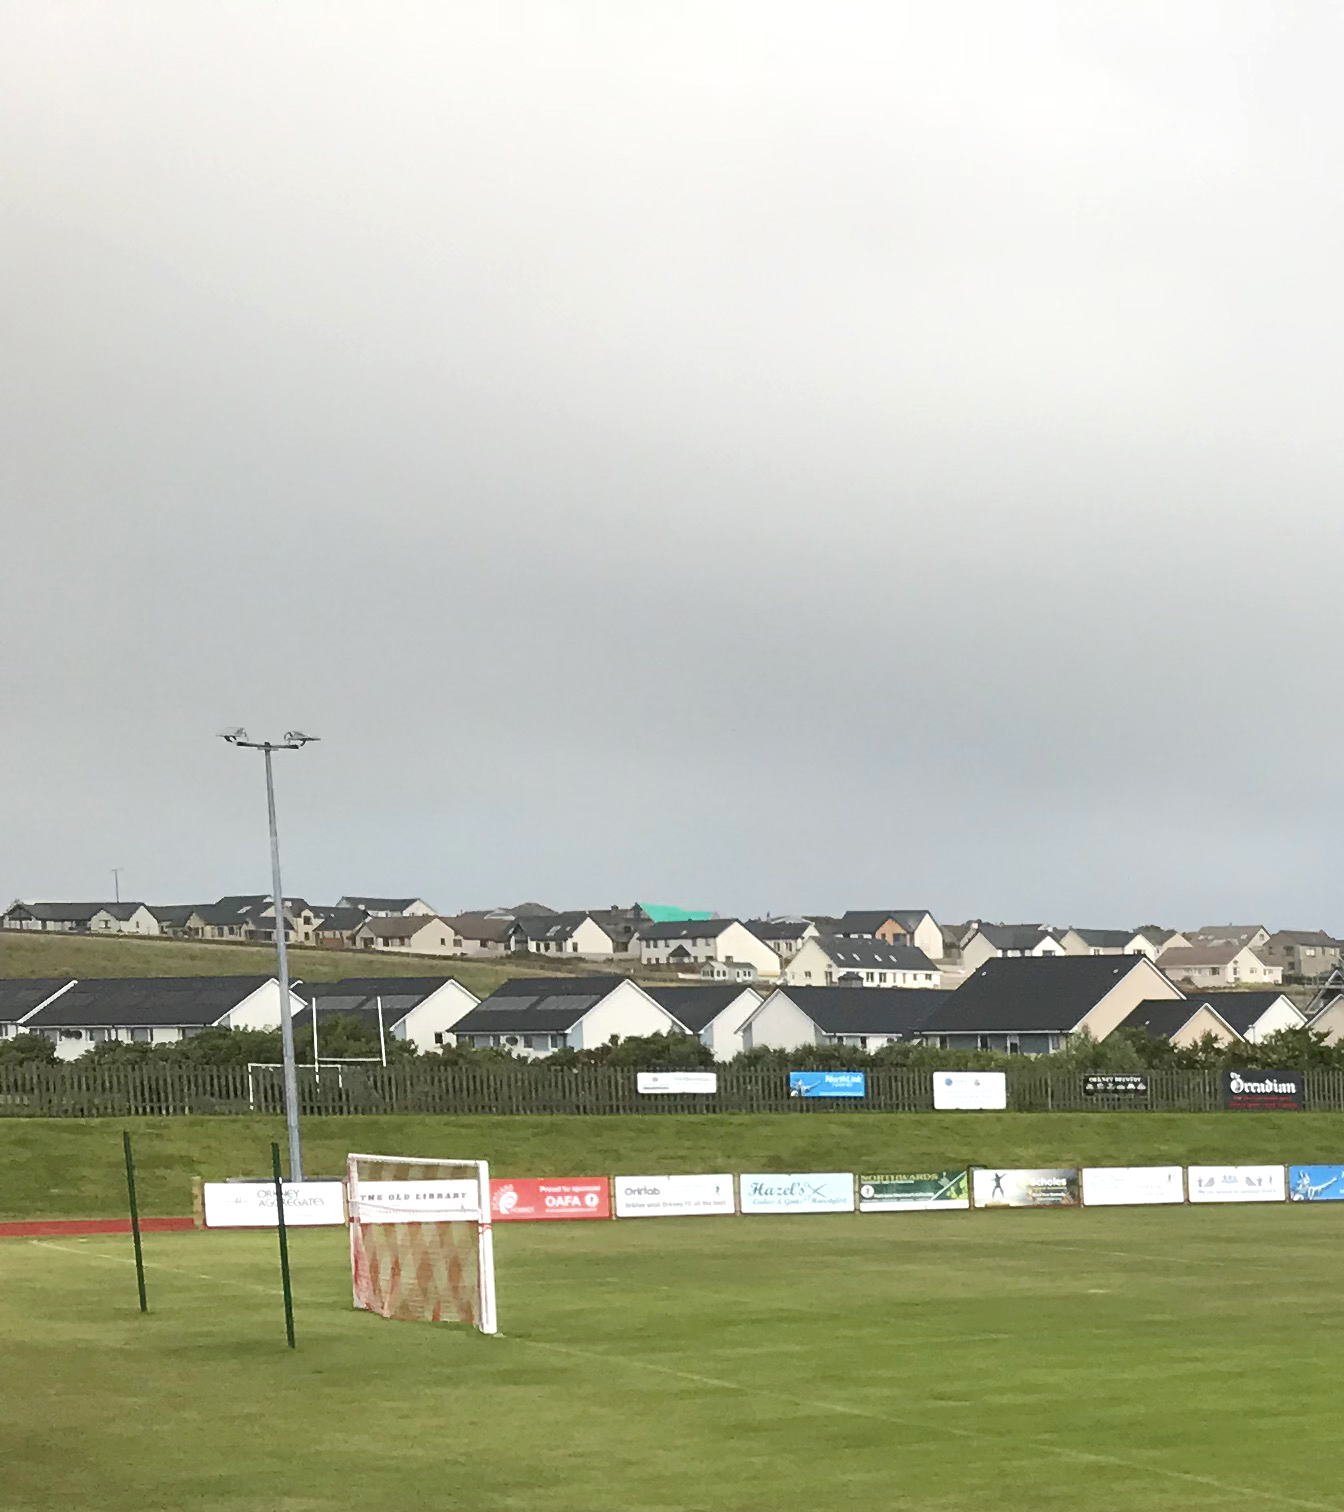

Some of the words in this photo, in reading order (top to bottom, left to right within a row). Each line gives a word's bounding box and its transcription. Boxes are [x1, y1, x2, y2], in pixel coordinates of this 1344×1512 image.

[1230, 1078, 1297, 1094] Orcadian
[748, 1182, 805, 1196] Hazel's
[545, 1195, 582, 1207] OAFA
